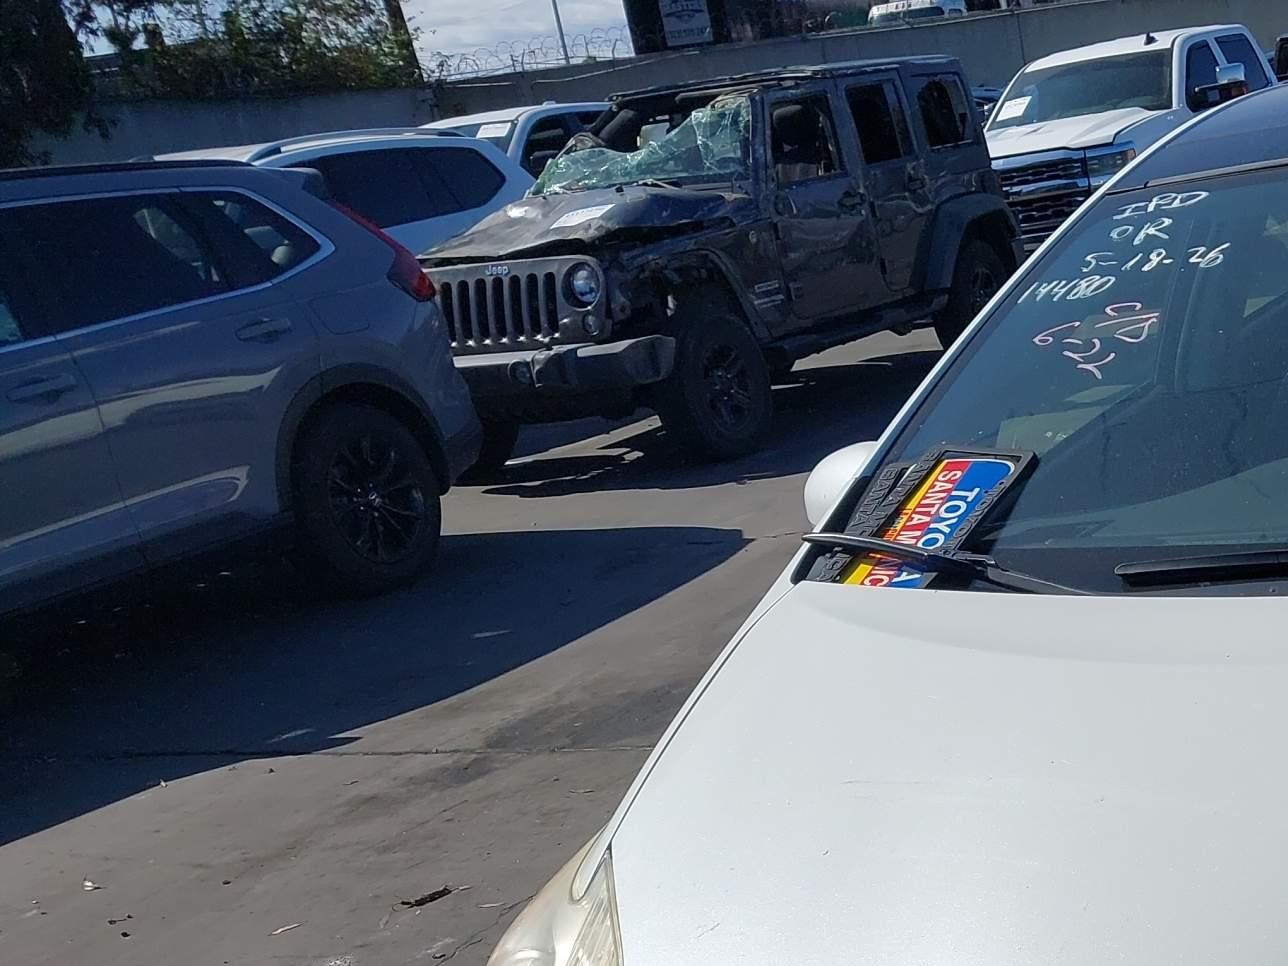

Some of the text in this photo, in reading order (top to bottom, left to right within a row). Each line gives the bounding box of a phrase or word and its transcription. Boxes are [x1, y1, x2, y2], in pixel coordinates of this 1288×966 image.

[485, 264, 510, 277] Jeep
[904, 469, 963, 526] SANTA
[890, 487, 981, 583] TOYOA
